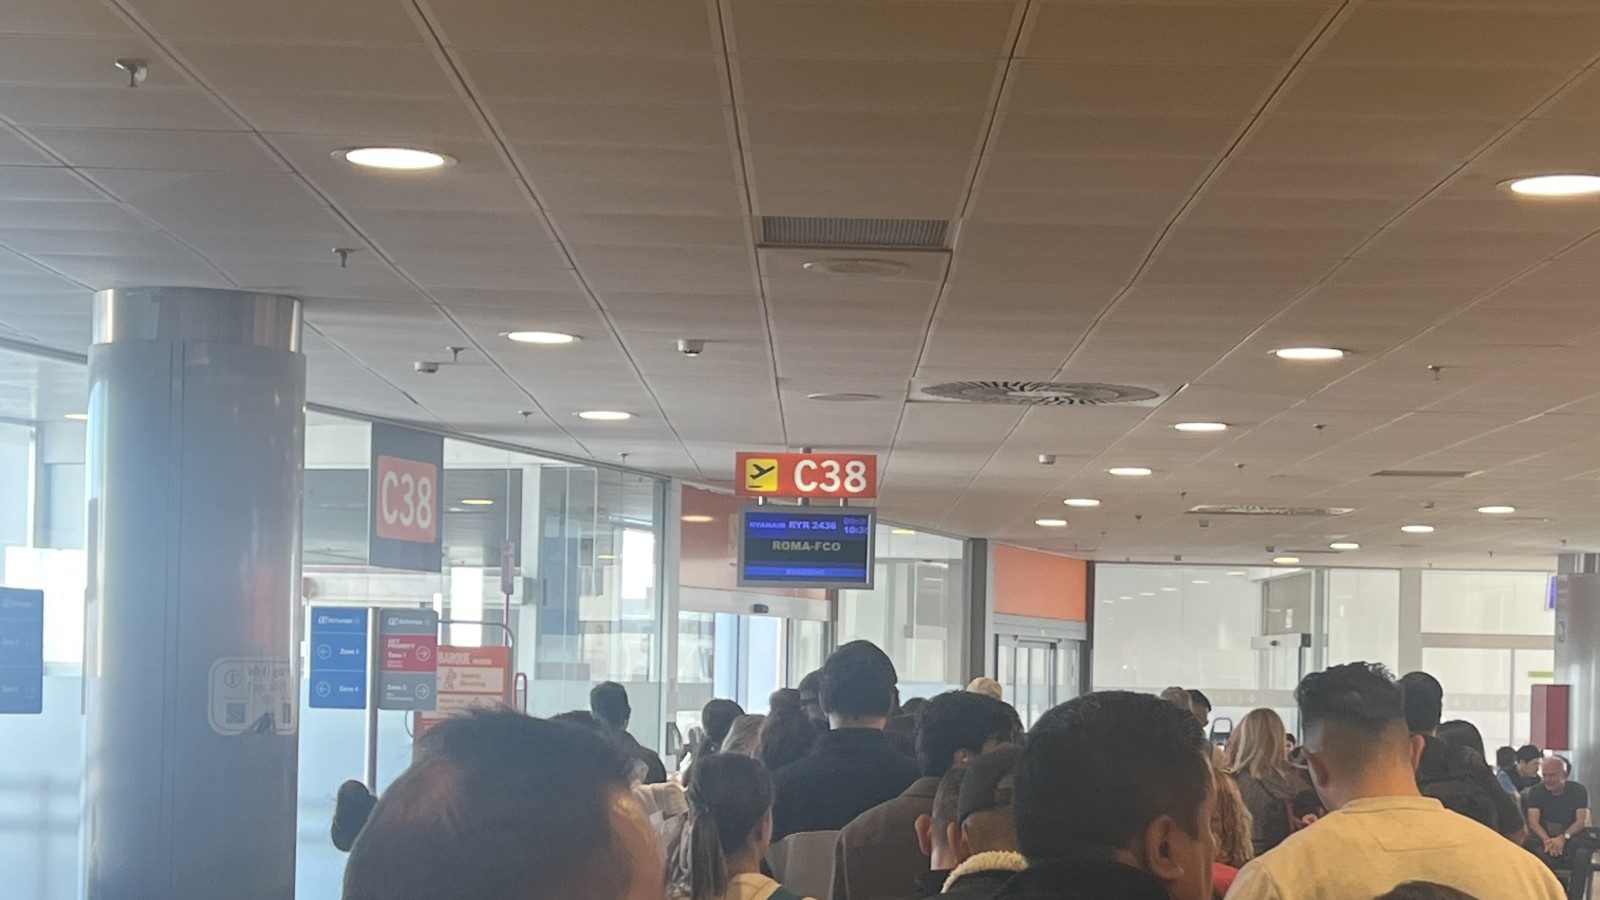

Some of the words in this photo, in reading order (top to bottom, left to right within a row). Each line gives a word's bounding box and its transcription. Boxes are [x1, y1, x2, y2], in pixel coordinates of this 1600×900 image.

[793, 459, 867, 493] C38
[381, 470, 432, 530] C38
[749, 521, 786, 529] RYANAIR
[788, 521, 810, 529] RYR
[812, 521, 837, 530] 2436
[772, 540, 841, 551] ROMA-FCO
